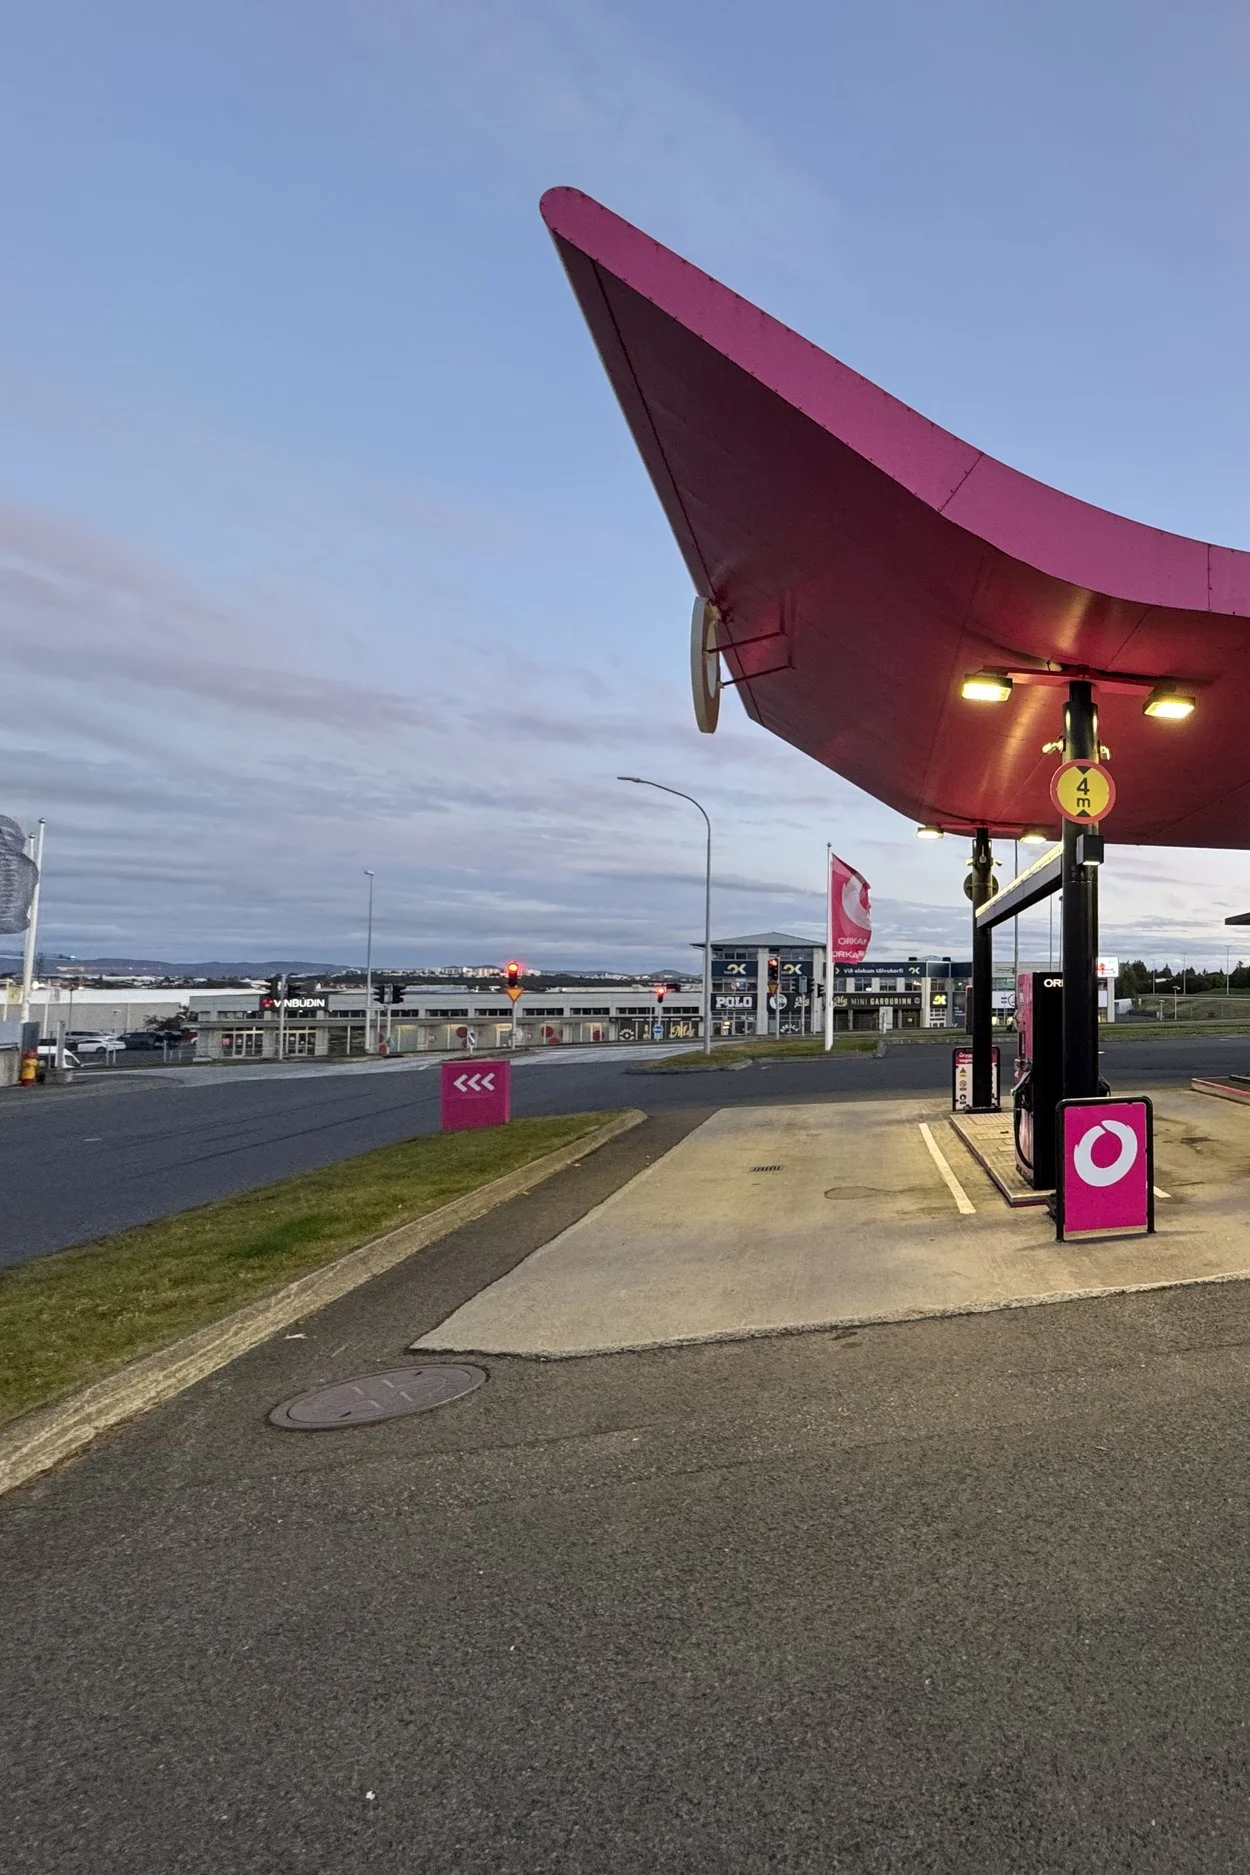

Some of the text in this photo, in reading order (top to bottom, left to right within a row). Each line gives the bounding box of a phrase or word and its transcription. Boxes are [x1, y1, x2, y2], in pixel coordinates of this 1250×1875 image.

[1076, 777, 1090, 795] 4
[1076, 797, 1091, 808] m
[272, 997, 326, 1008] VNBÚÐIN
[715, 996, 753, 1009] POLO
